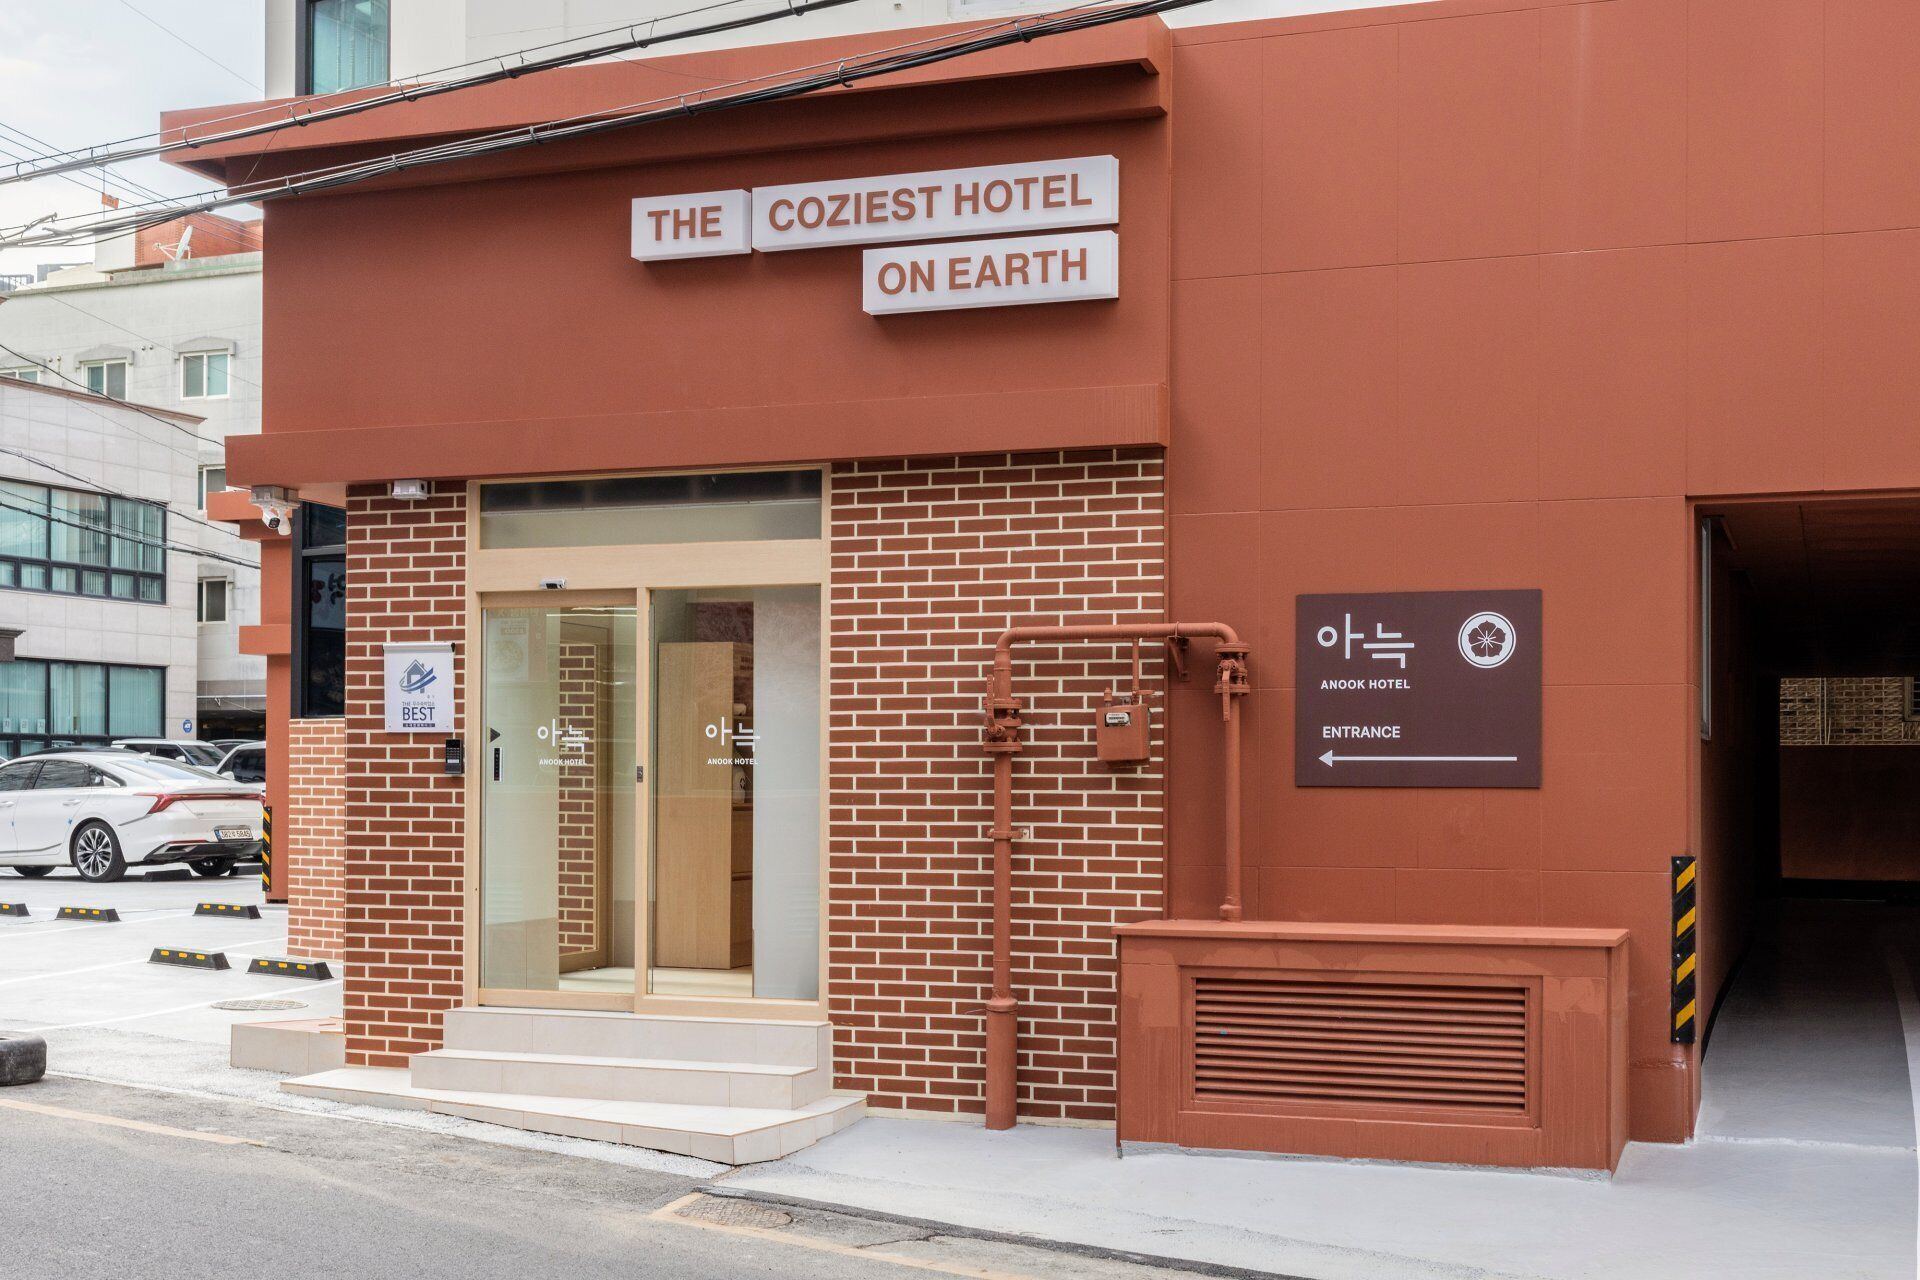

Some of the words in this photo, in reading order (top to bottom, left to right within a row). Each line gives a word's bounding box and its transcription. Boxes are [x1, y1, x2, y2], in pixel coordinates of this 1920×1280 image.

[647, 205, 722, 241] THE
[768, 185, 942, 232] COZIEST
[954, 173, 1093, 216] HOTEL
[877, 262, 935, 295] ON
[948, 247, 1087, 290] EARTH
[1317, 613, 1415, 669] 아늑
[1320, 680, 1365, 690] ANOOK
[1369, 679, 1411, 689] HOTEL
[402, 706, 435, 721] BEST
[537, 718, 590, 753] 아늑
[705, 716, 760, 752] 아늑
[1322, 726, 1401, 738] ENTRANCE
[539, 758, 563, 766] ANOOK
[564, 758, 588, 766] HOTEL
